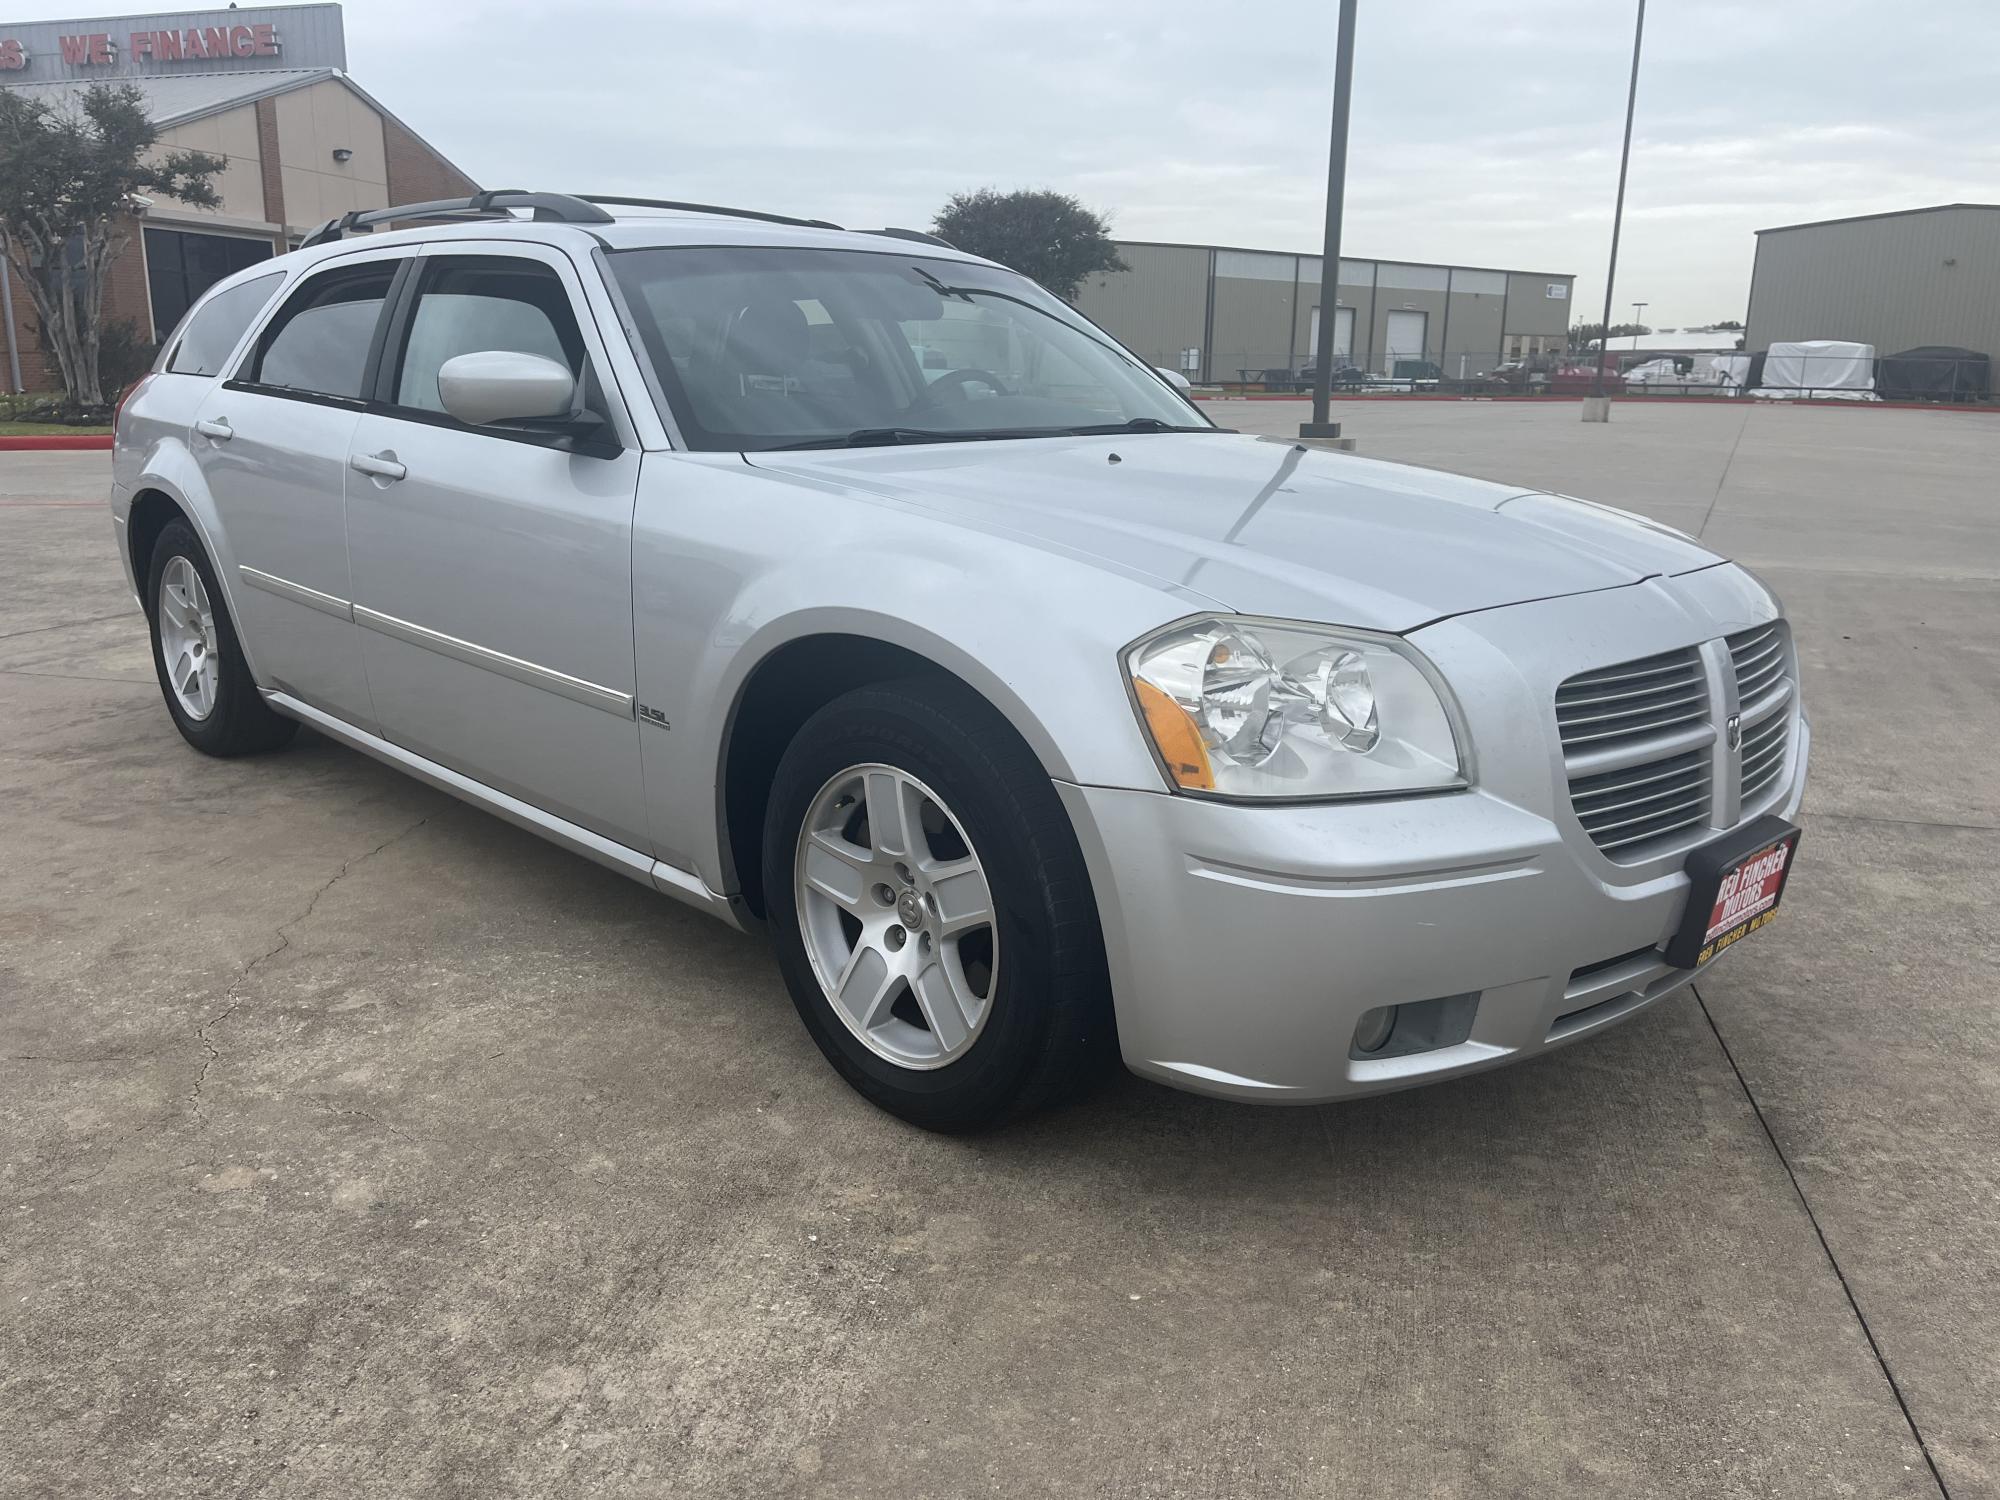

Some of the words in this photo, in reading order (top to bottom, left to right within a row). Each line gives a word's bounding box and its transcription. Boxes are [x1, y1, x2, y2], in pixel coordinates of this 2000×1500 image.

[59, 33, 113, 65] WE
[130, 24, 277, 63] FINANCE
[1739, 846, 1788, 891] FINCHER
[1721, 880, 1764, 921] MOTORS
[1716, 924, 1747, 953] FINCHER
